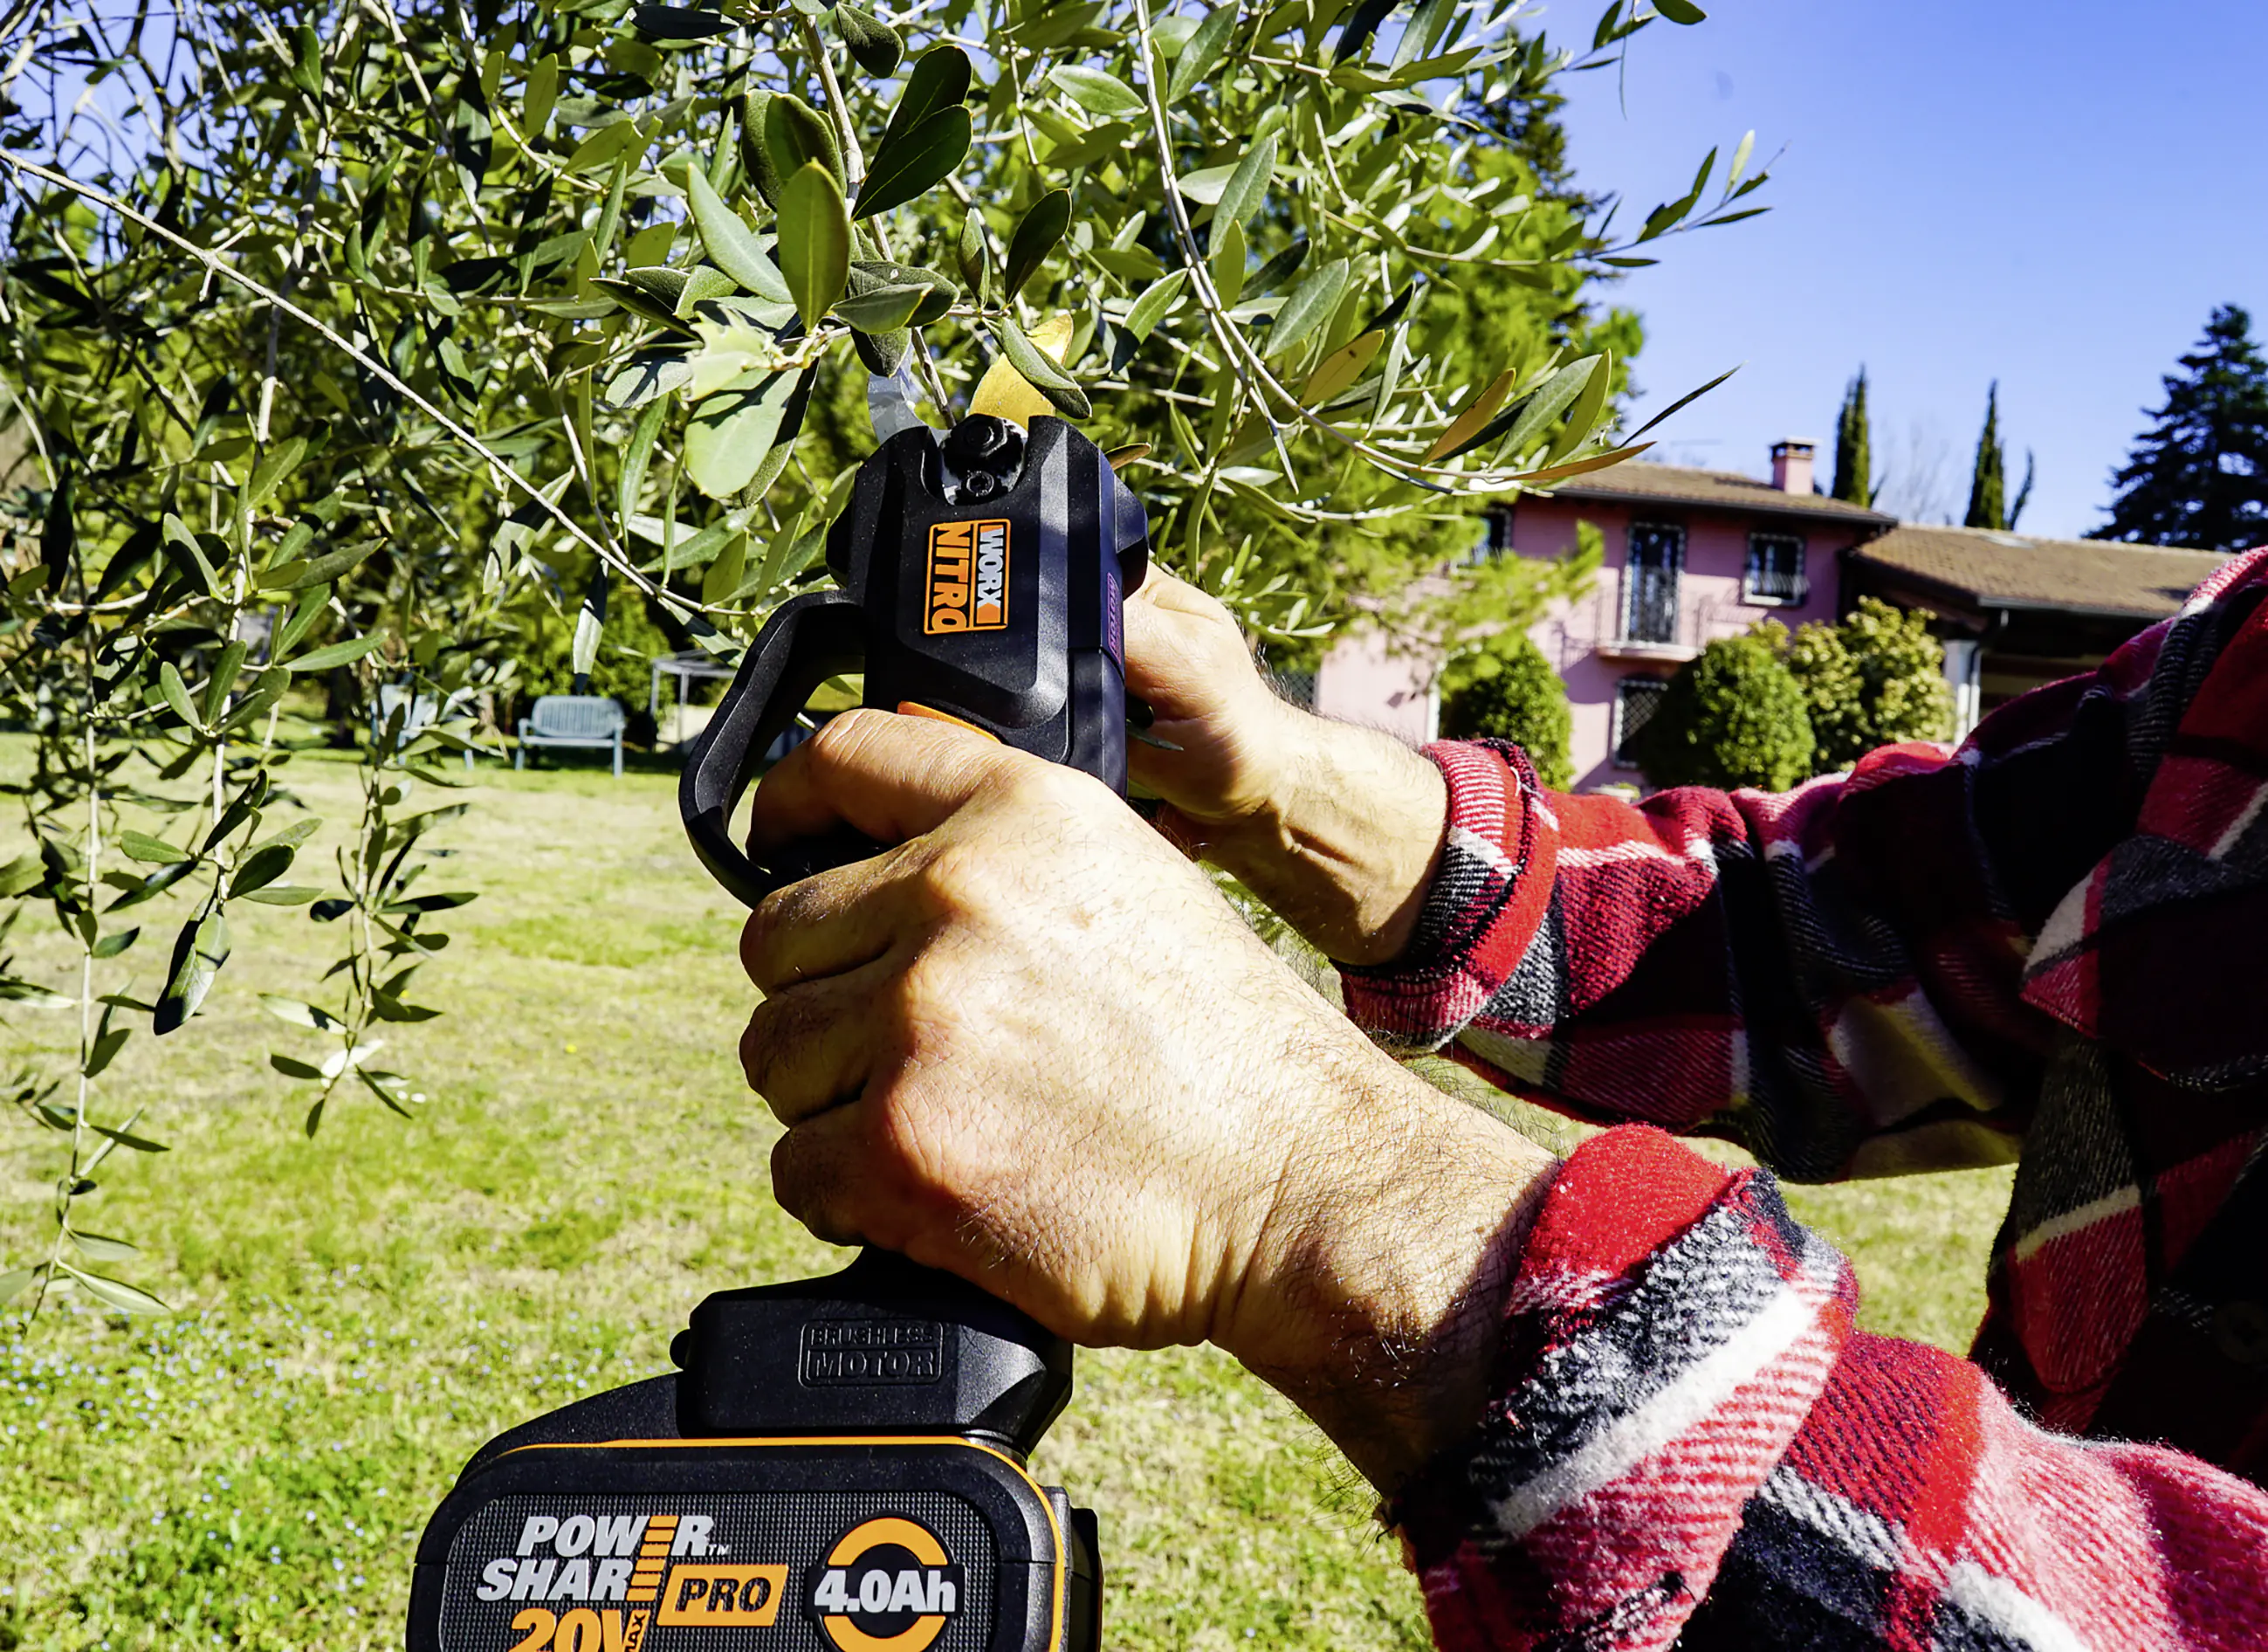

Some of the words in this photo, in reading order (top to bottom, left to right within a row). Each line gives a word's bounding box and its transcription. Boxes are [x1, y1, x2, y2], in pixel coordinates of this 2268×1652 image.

[931, 524, 971, 630] NITRO
[978, 526, 1004, 609] WORX
[811, 1326, 933, 1346] BRUSHLESS
[813, 1350, 934, 1378] MOTOR
[515, 1515, 714, 1557] POWER
[477, 1559, 665, 1601] SHARE
[674, 1577, 772, 1613] PRO
[814, 1569, 957, 1613] 4.0Ah
[508, 1607, 629, 1651] 20V
